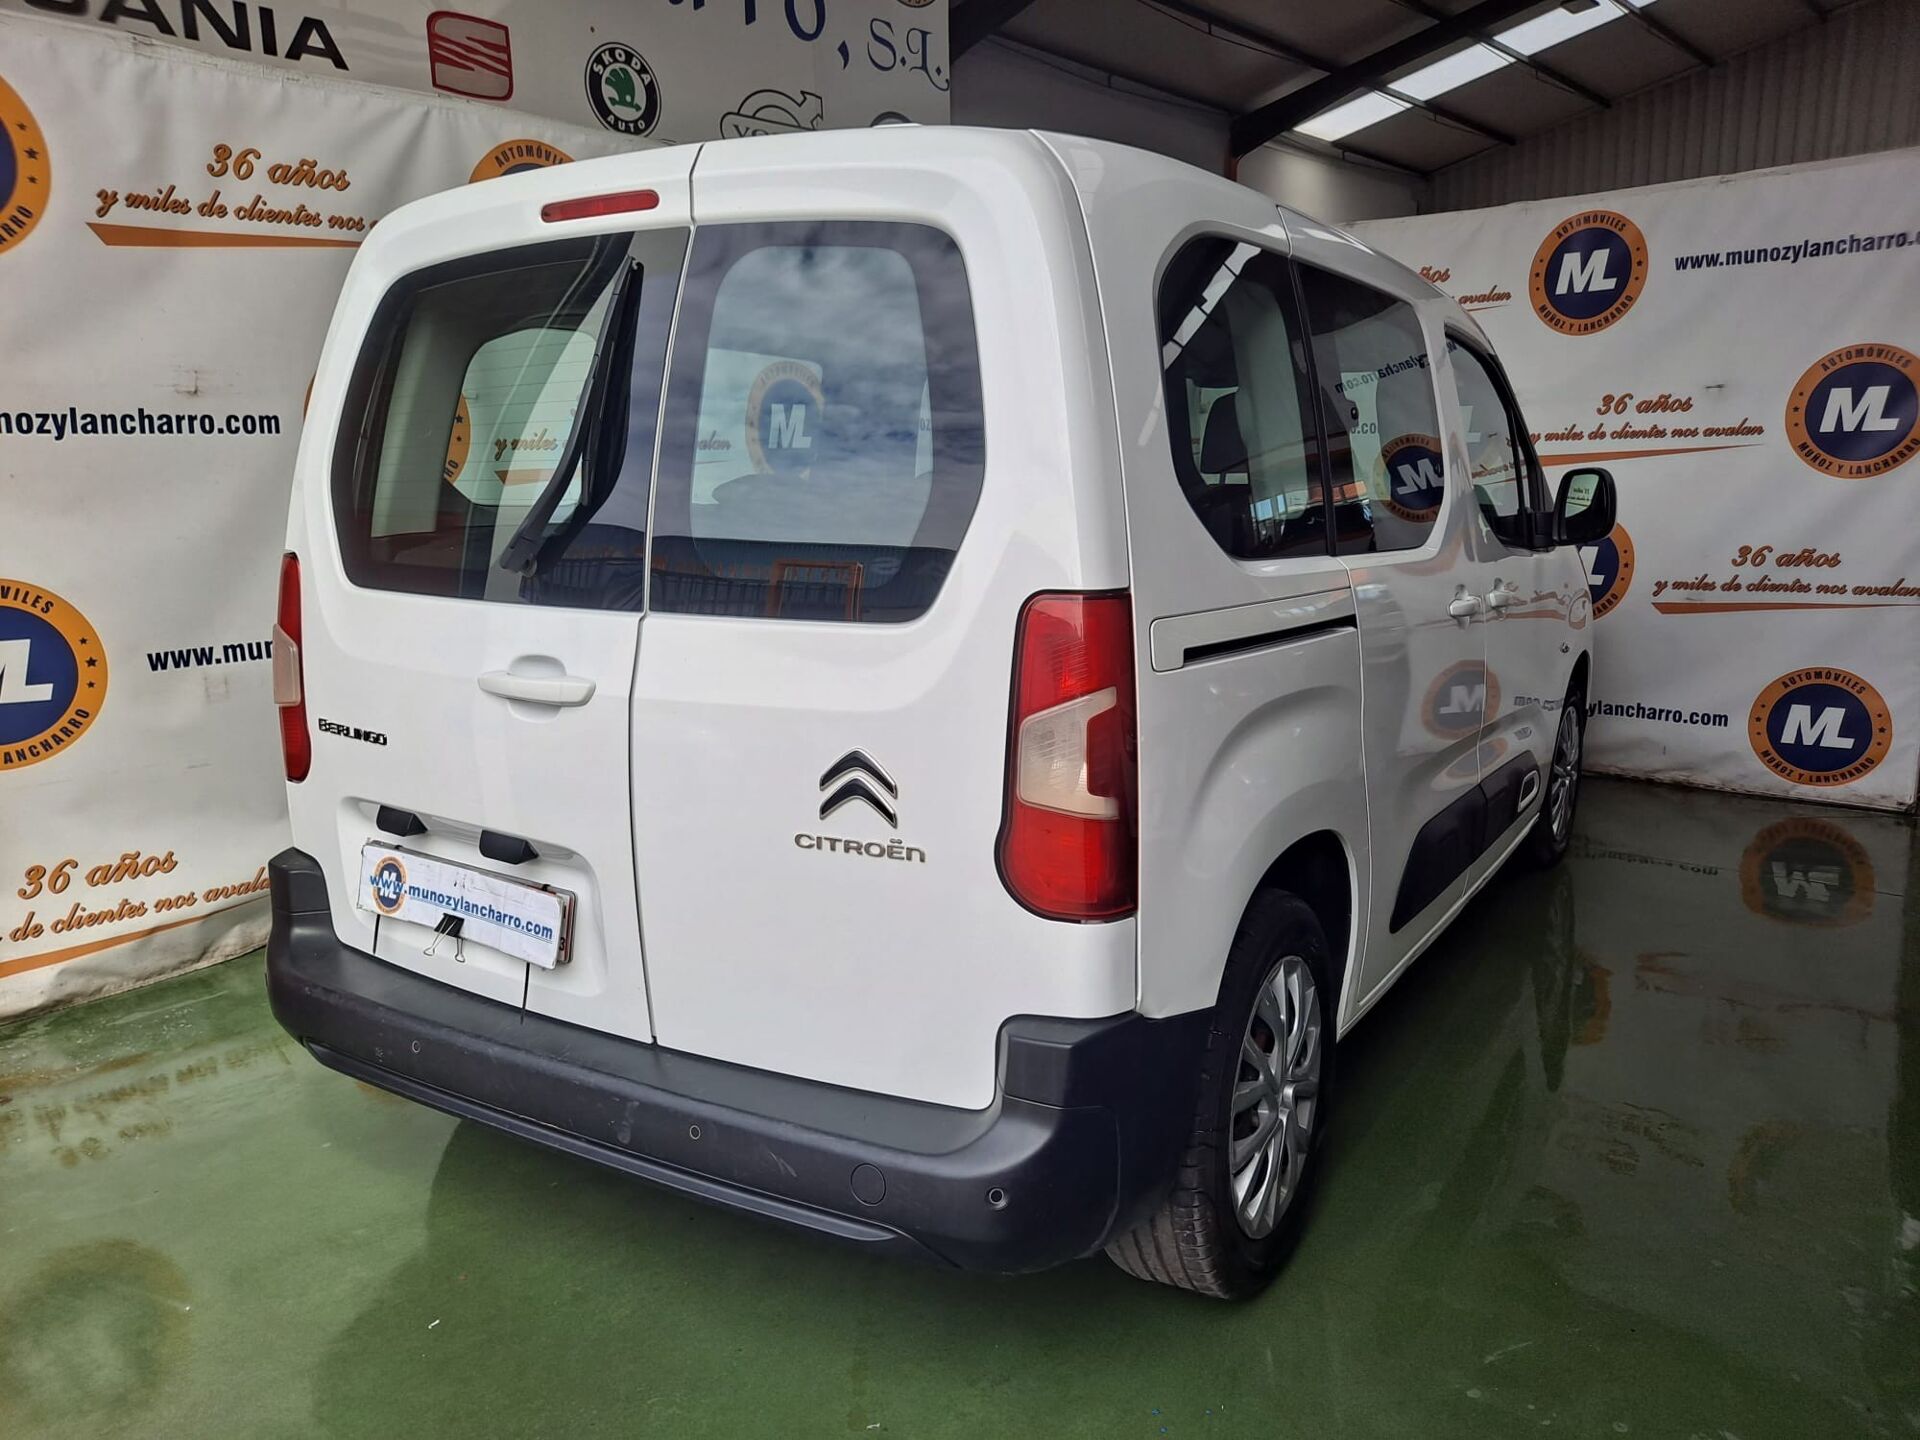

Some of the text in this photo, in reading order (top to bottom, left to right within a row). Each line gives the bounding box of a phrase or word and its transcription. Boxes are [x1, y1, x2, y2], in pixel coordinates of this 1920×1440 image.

[24, 0, 350, 71] ANIA
[592, 46, 652, 86] SKODA
[606, 113, 646, 133] AUTO
[207, 143, 351, 191] 36 años
[95, 184, 366, 232] y miles de clientes nos
[1555, 247, 1618, 295] ML
[1596, 393, 1694, 416] 36 años
[1819, 385, 1900, 433] ML
[1544, 424, 1584, 442] miles
[1588, 423, 1607, 441] de
[1610, 422, 1668, 440] clientes
[1670, 427, 1699, 439] nos
[1702, 417, 1765, 438] avalan
[1731, 545, 1842, 569] 36 años
[1652, 578, 1668, 597] y
[1672, 574, 1716, 592] miles
[1720, 574, 1743, 592] de
[1746, 574, 1812, 594] clientes
[1815, 583, 1848, 595] nos
[1782, 671, 1866, 695] AUTOMÓVILES
[3, 708, 90, 765] ANCHARRO
[318, 718, 387, 746] BERLINGO
[1780, 703, 1855, 749] ML
[1809, 757, 1875, 783] LANCHARRO
[17, 850, 178, 900] 36 años
[8, 866, 271, 942] de clientes nos avala
[369, 875, 553, 939] www.munozylancharro.com
